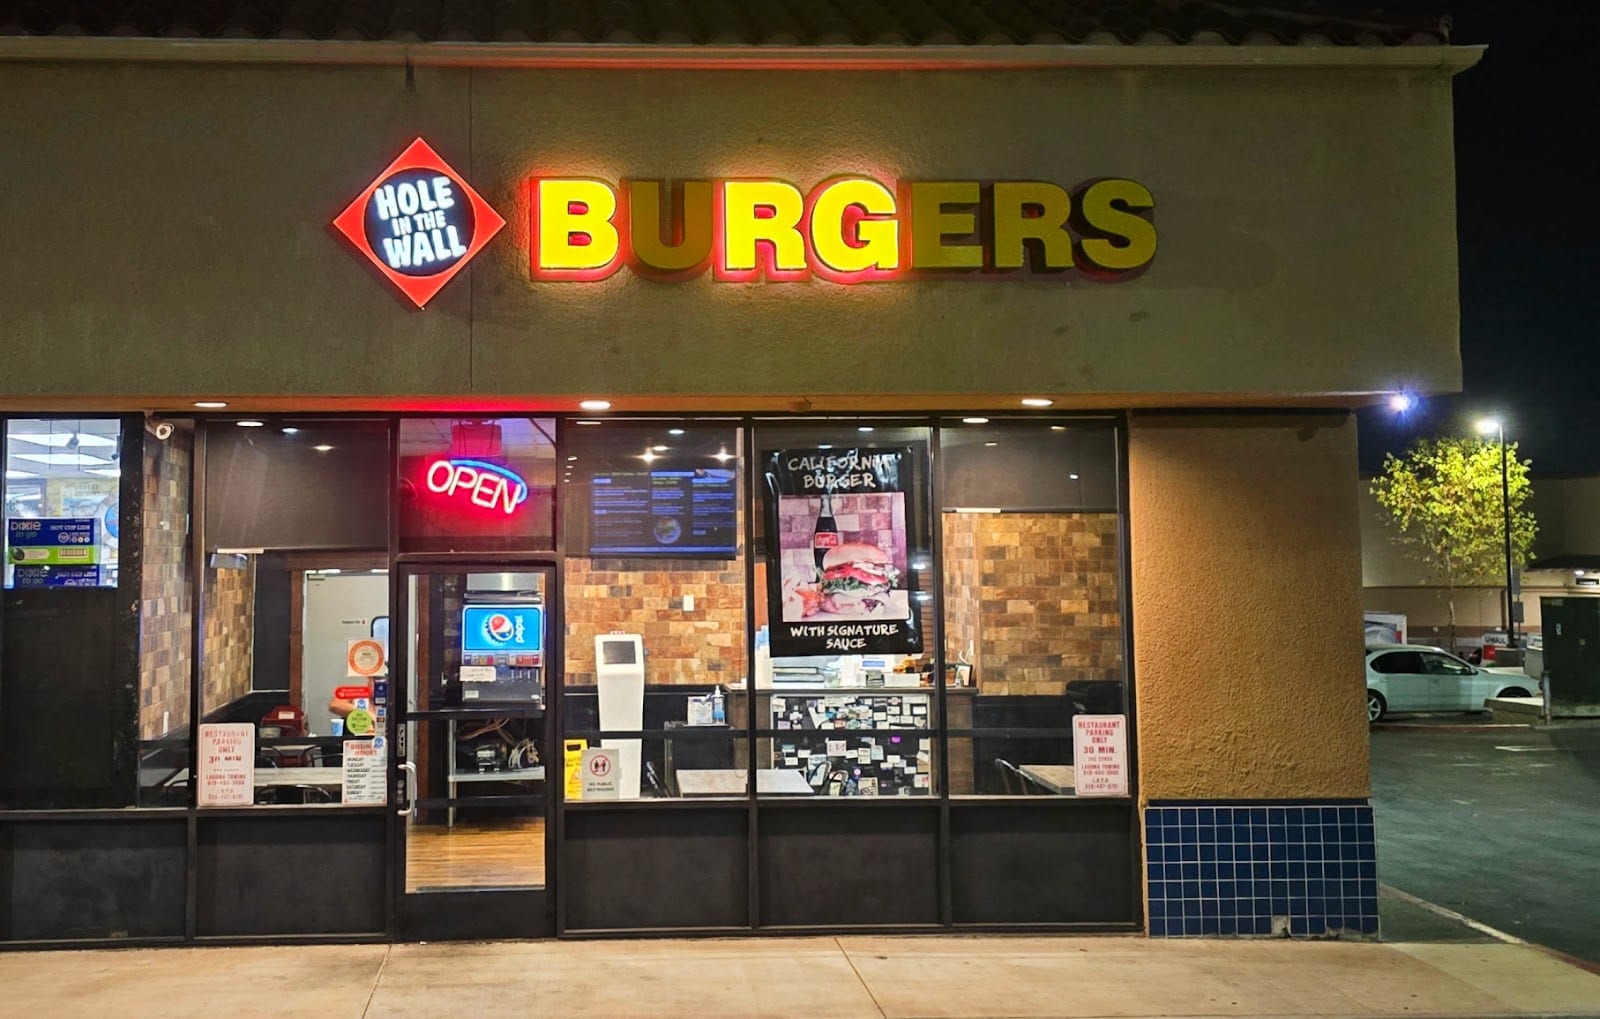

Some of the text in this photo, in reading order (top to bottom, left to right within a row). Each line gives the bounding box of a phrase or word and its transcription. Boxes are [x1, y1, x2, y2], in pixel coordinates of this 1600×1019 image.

[375, 176, 455, 220] HOLE
[391, 210, 447, 236] IN THE
[539, 178, 1158, 270] BURGERS
[382, 225, 467, 268] WALL
[427, 461, 521, 513] OPEN
[803, 473, 876, 488] BURGER
[790, 624, 899, 637] WITH SIGNATURE
[826, 638, 867, 649] SAUCE
